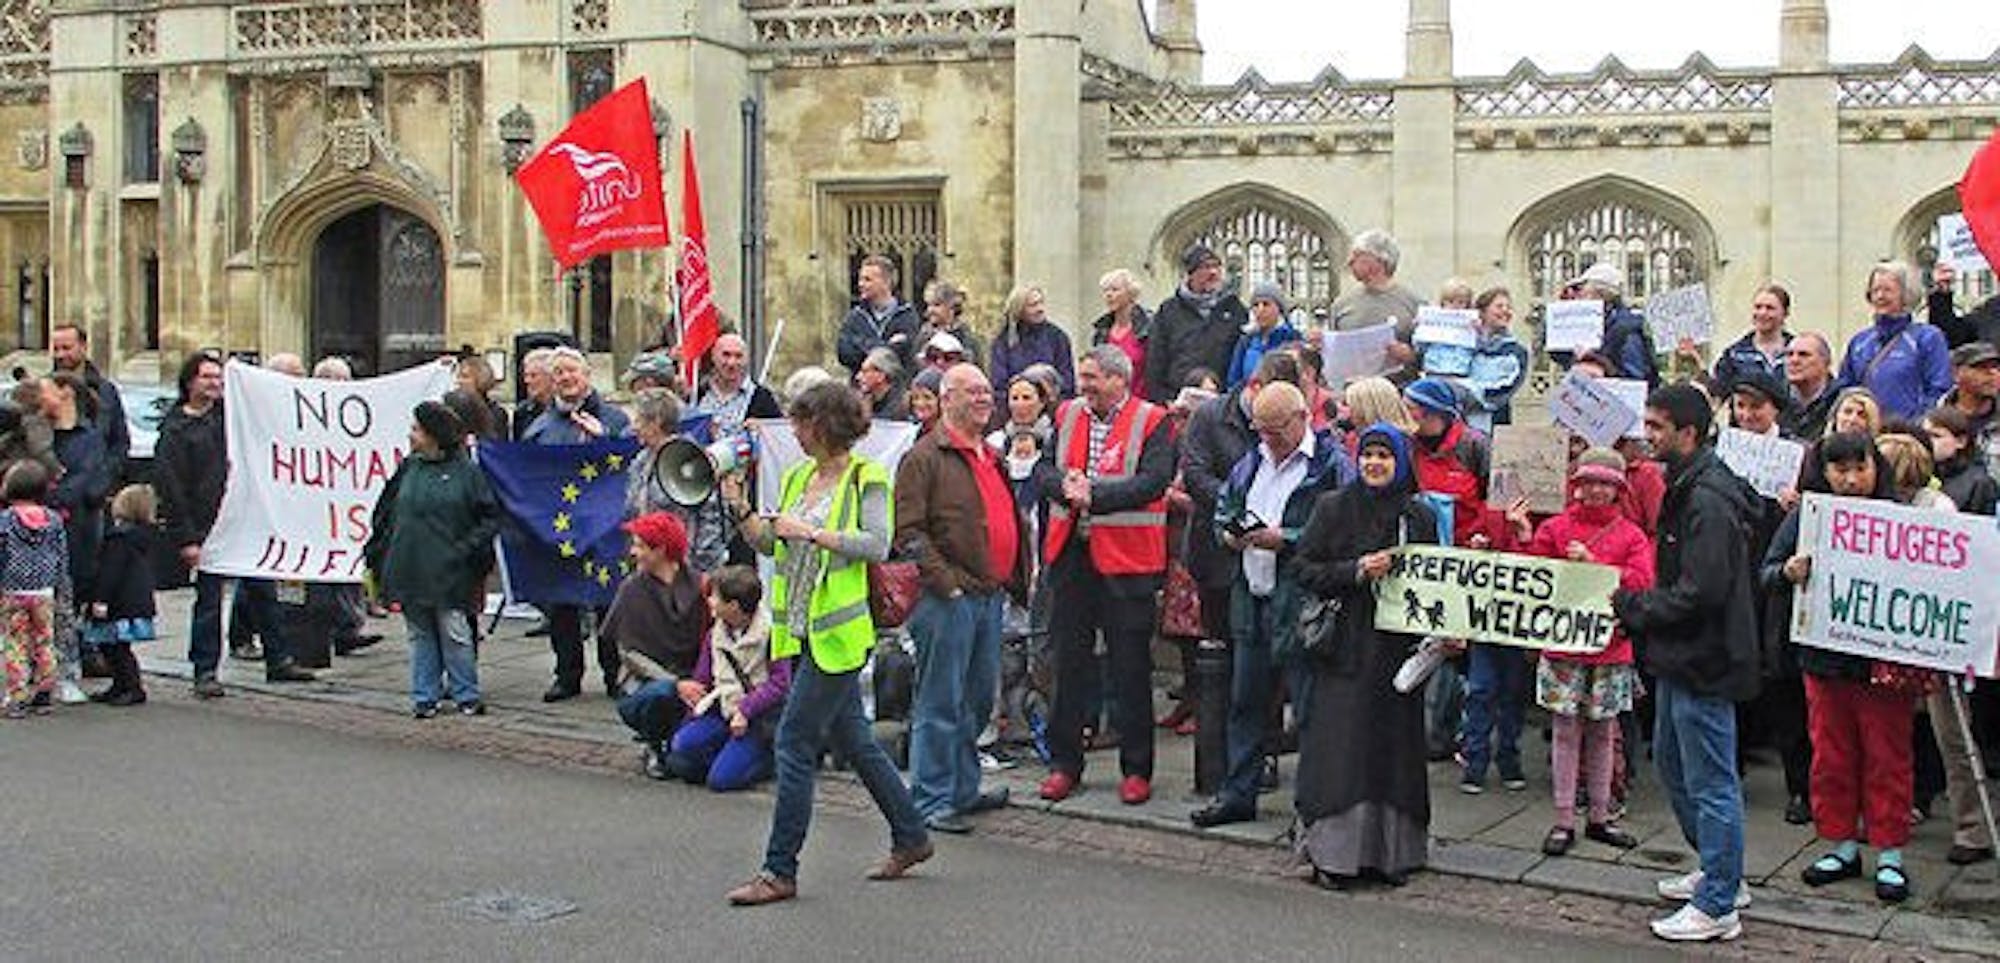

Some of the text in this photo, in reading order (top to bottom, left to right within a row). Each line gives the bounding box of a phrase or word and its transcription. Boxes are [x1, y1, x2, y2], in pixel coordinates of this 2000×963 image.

[294, 387, 372, 438] NO
[328, 501, 369, 543] IS
[1831, 509, 1971, 570] REFUGEES
[1467, 595, 1615, 648] WELCOME
[1830, 573, 1973, 645] WELCOME
